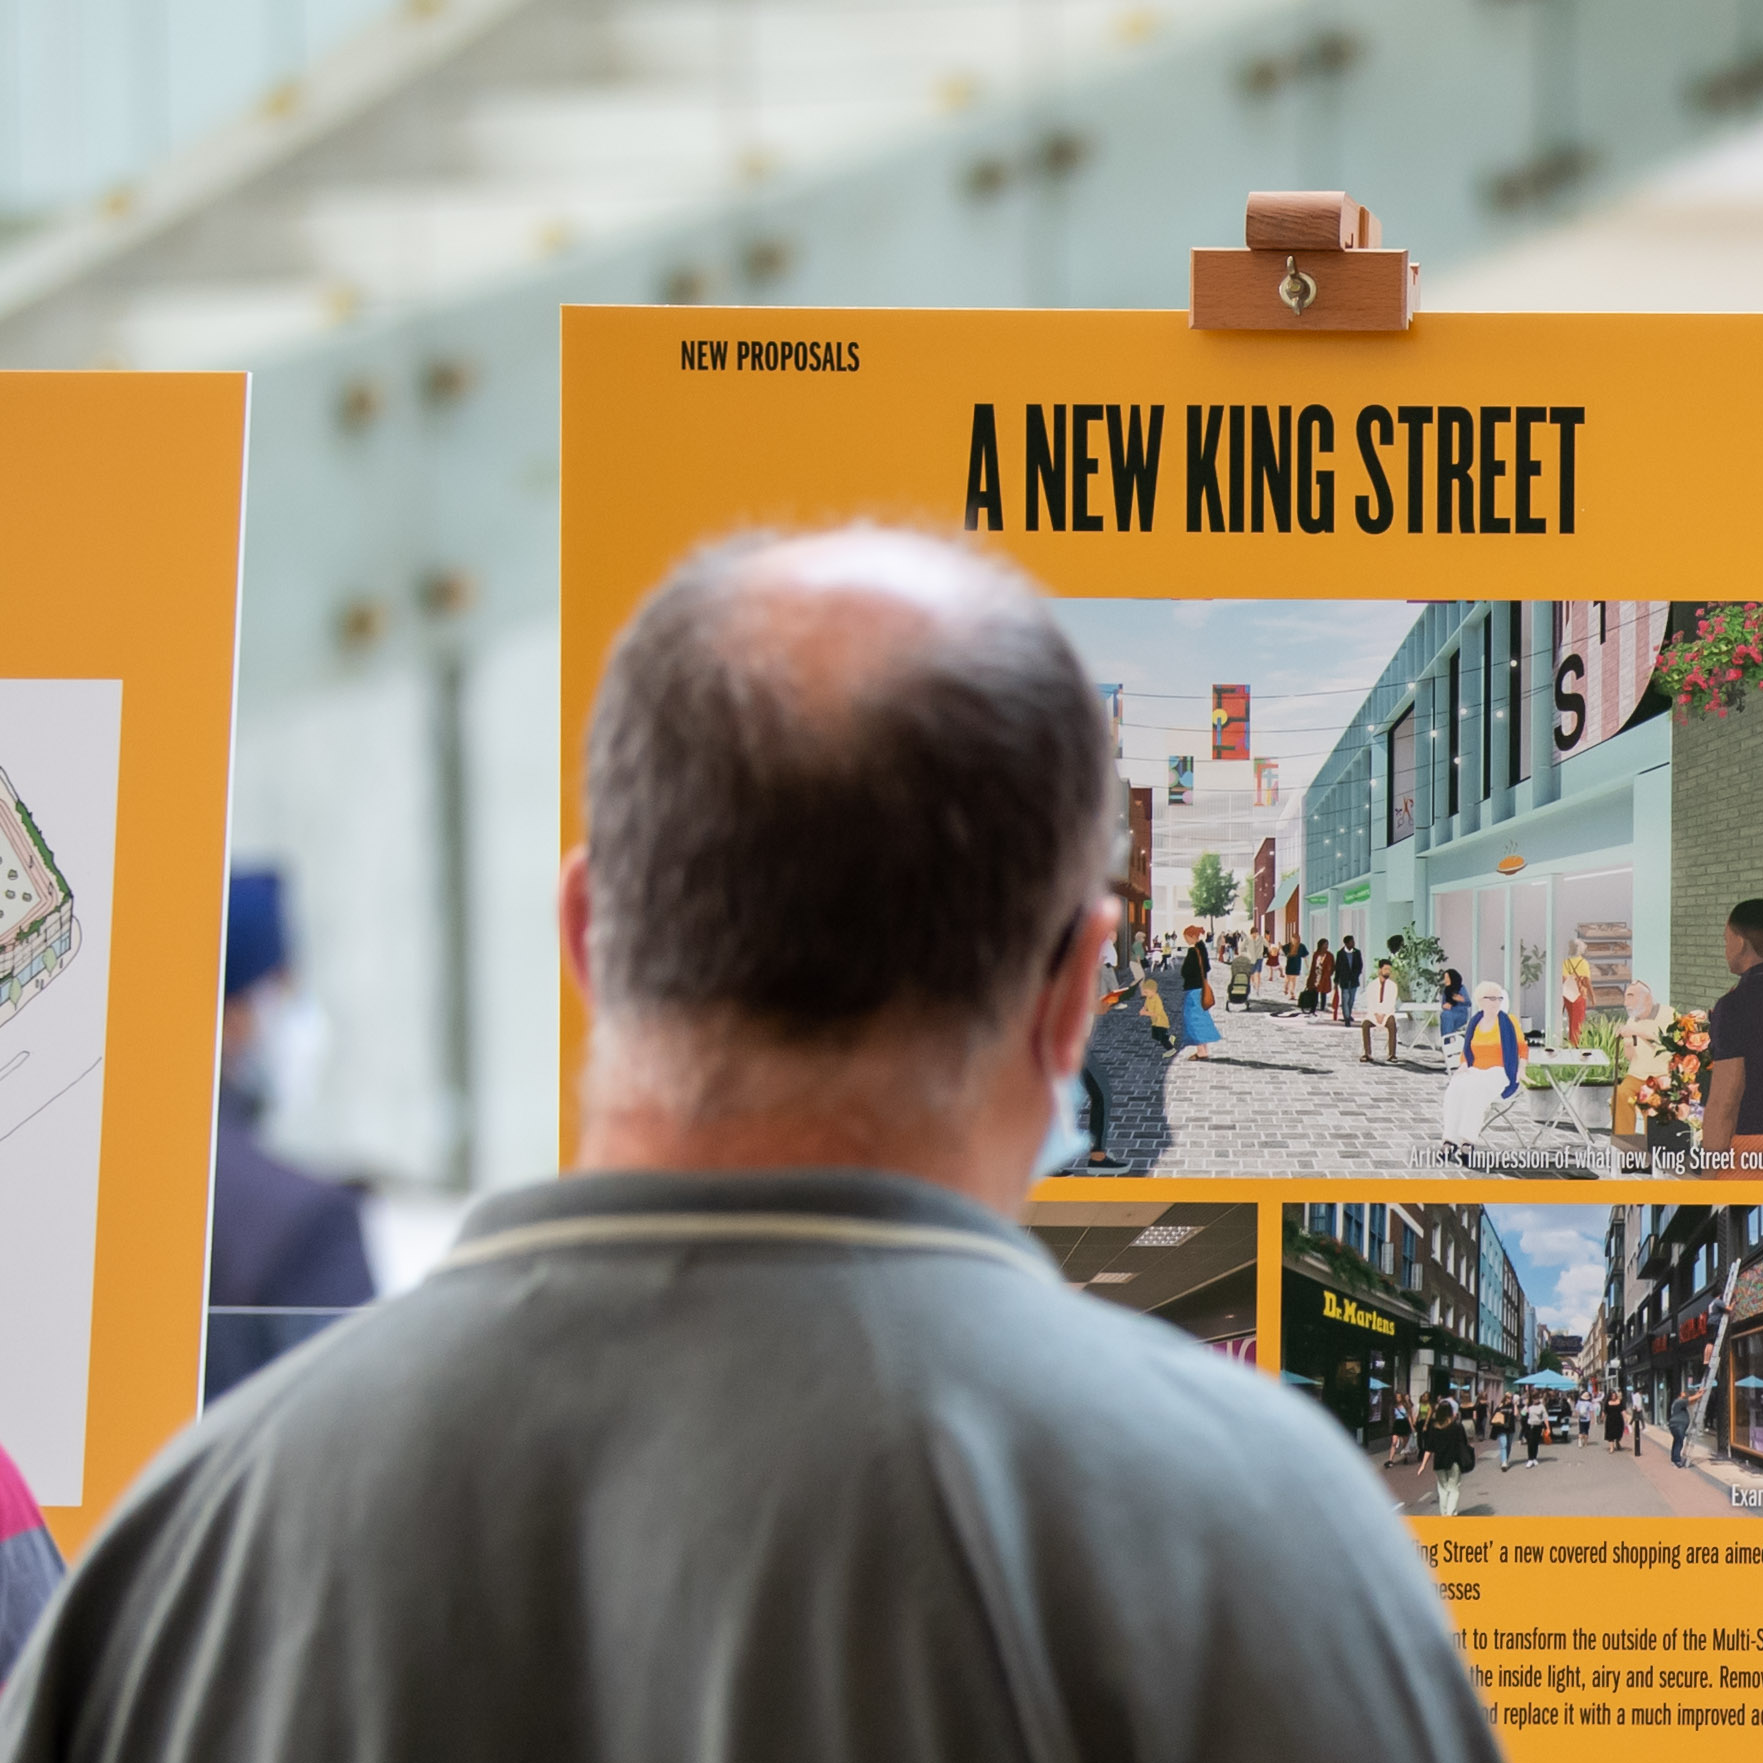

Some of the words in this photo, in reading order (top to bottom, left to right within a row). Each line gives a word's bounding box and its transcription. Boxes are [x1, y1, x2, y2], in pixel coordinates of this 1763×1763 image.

[681, 340, 728, 370] NEW
[737, 341, 859, 371] PROPOSALS
[965, 403, 1003, 531] A
[1025, 403, 1164, 532] NEW
[1186, 404, 1334, 534] KING
[1355, 404, 1585, 534] STREET
[1468, 1146, 1549, 1175] impression
[1554, 1147, 1571, 1169] of
[1574, 1147, 1612, 1170] what
[1616, 1151, 1647, 1170] new
[1652, 1147, 1686, 1176] King
[1690, 1146, 1736, 1171] Street
[1499, 1545, 1508, 1563] a
[1514, 1545, 1544, 1563] new
[1549, 1540, 1606, 1563] covered
[1612, 1540, 1680, 1569] shopping
[1686, 1546, 1718, 1564] area
